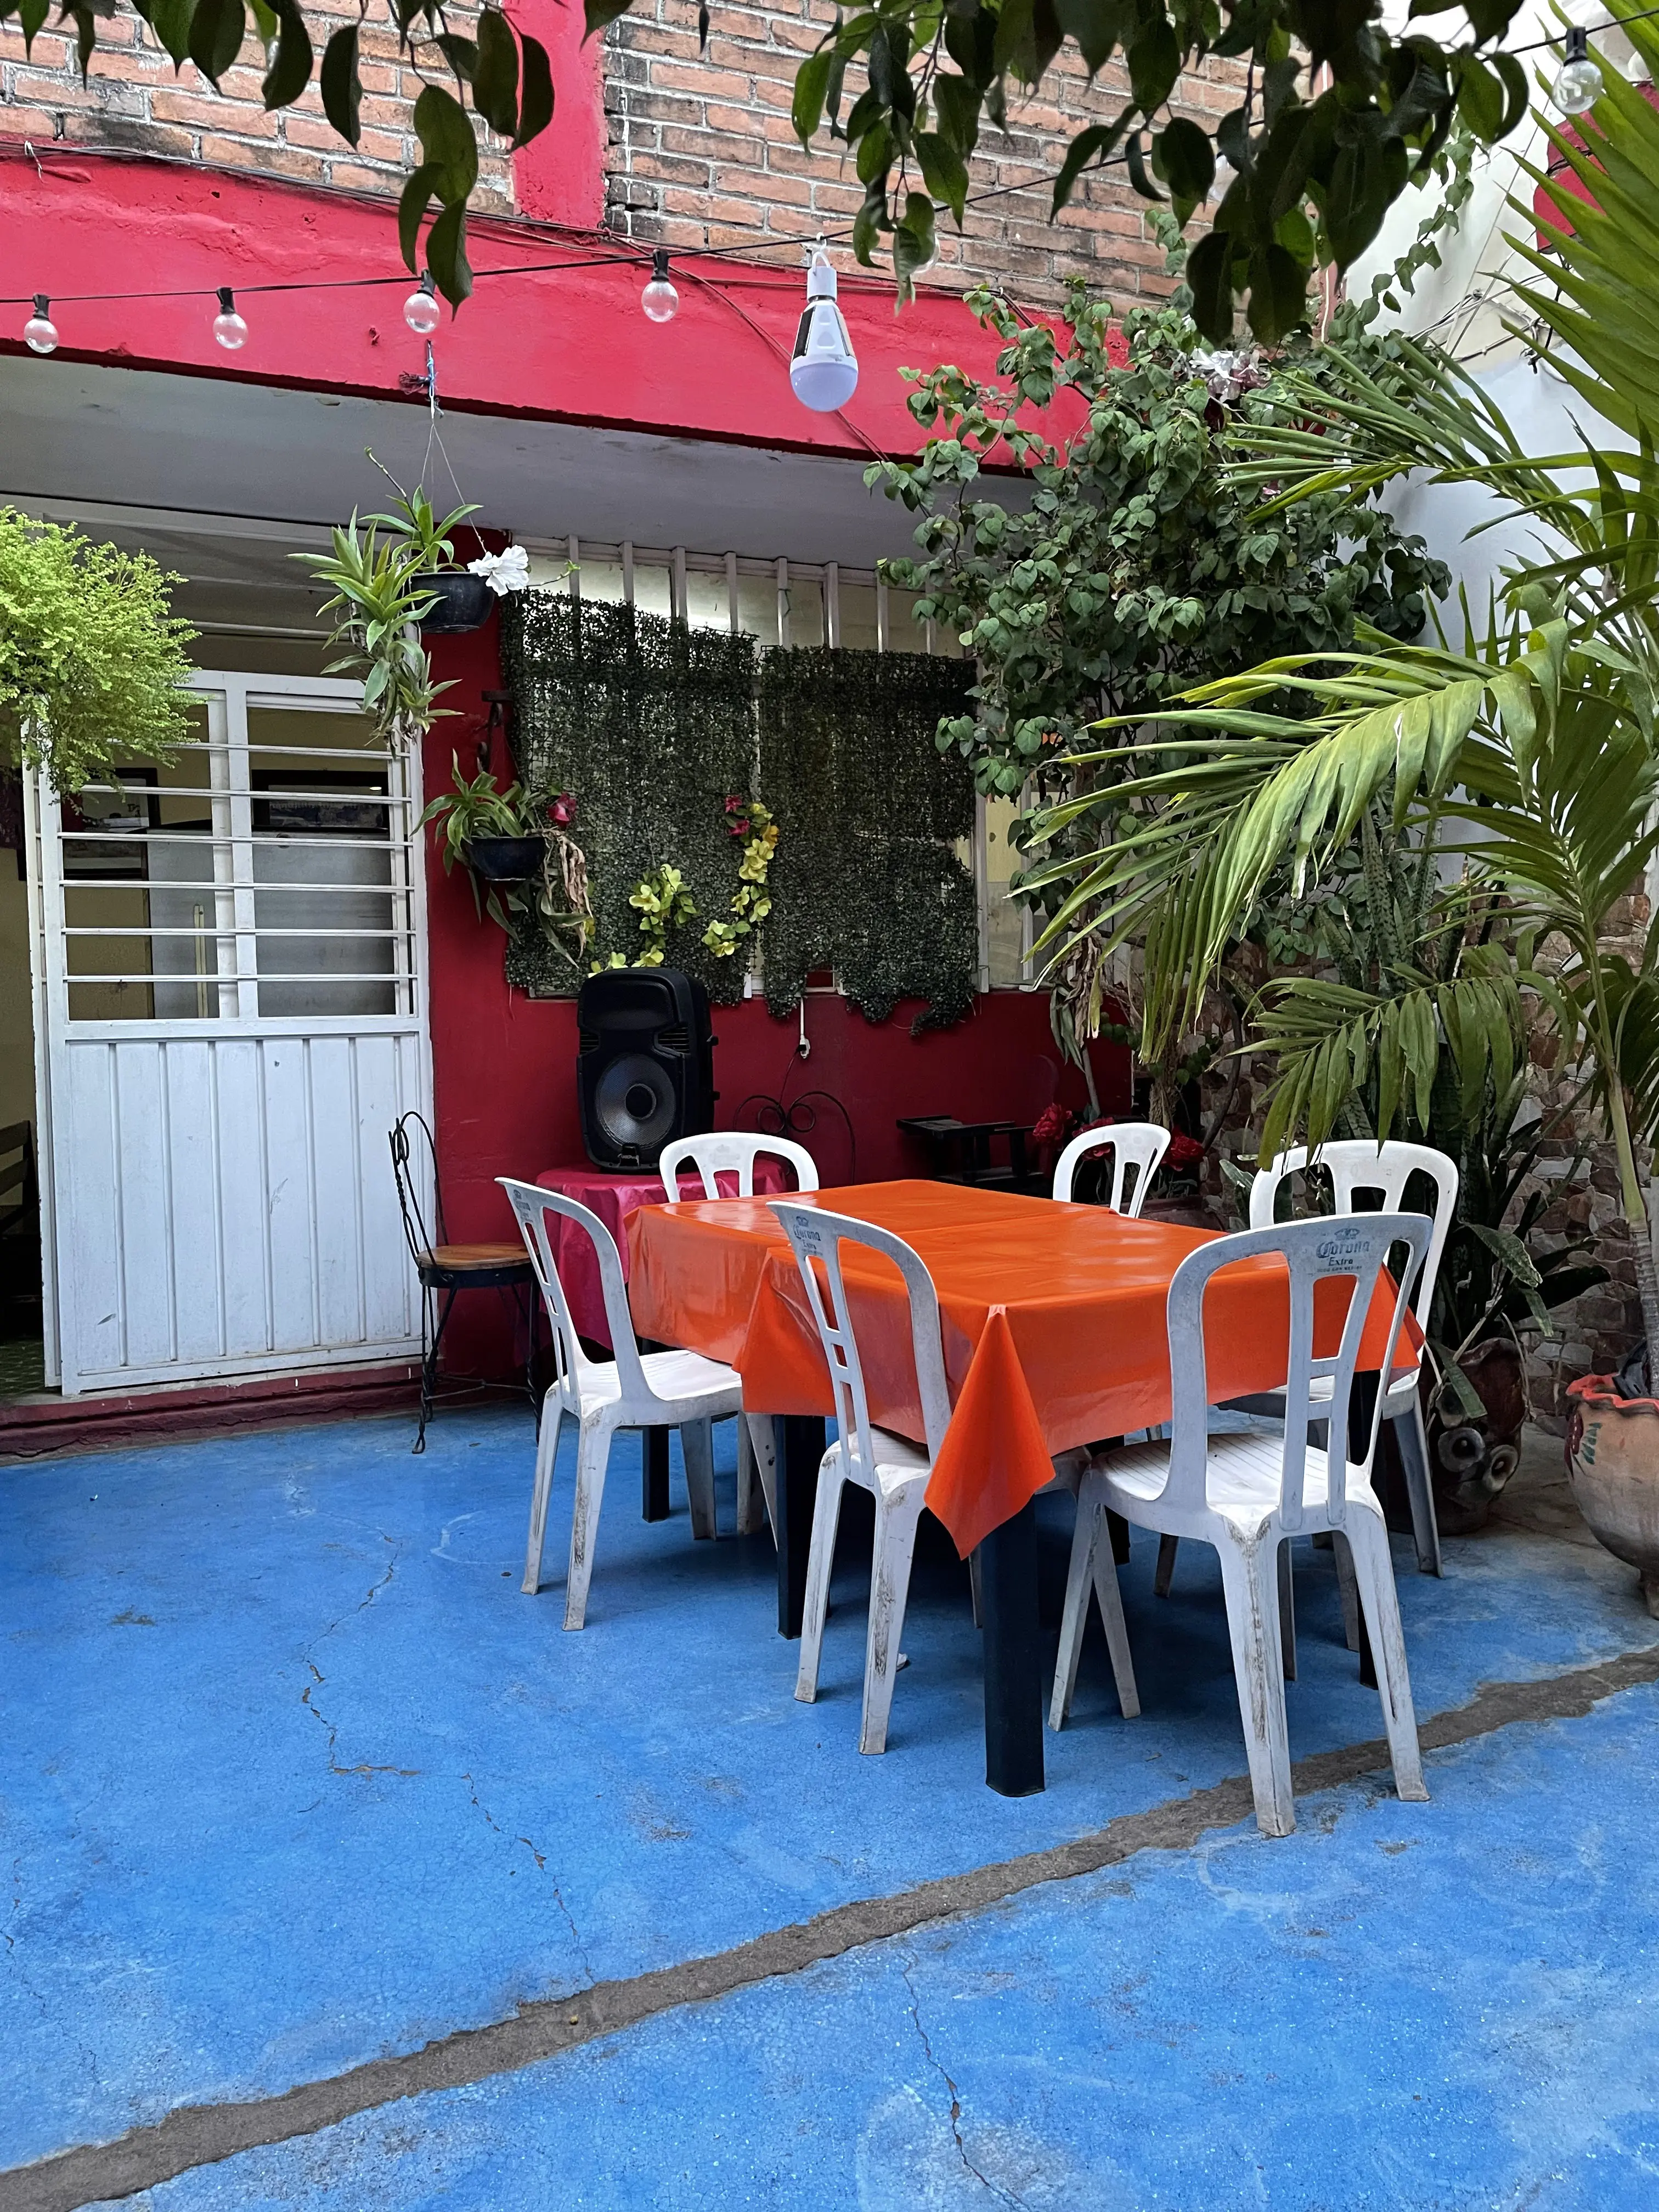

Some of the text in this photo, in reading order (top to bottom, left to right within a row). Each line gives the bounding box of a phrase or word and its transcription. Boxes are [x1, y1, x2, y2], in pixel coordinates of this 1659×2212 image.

[793, 1224, 821, 1242] Corona
[1316, 1241, 1370, 1259] Corona
[1328, 1256, 1353, 1266] Extra
